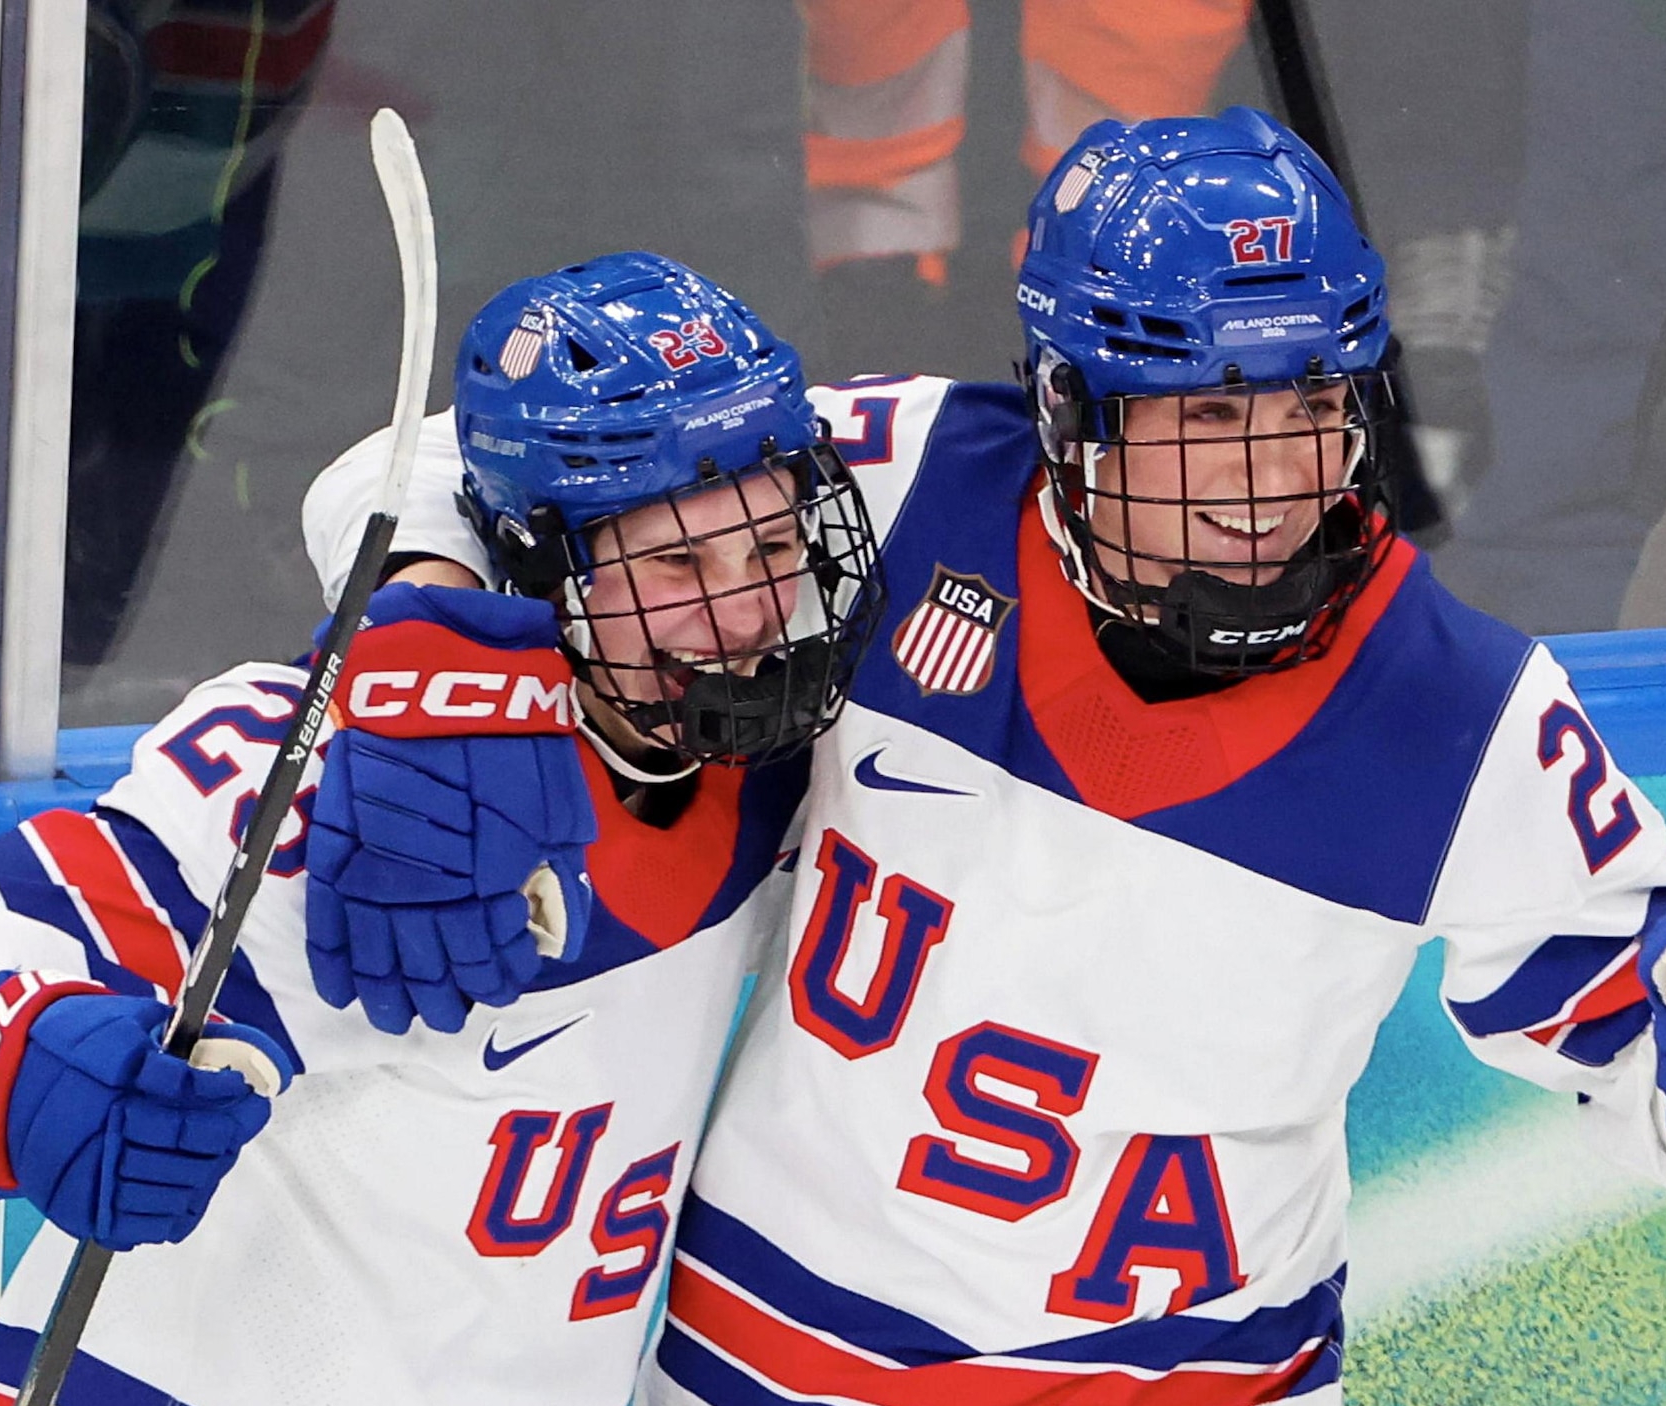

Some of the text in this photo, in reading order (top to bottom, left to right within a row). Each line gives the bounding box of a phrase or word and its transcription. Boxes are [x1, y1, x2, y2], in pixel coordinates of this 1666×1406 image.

[1229, 217, 1296, 266] 27
[520, 313, 546, 331] USA
[1016, 283, 1056, 316] CCM
[1220, 313, 1322, 331] MILANO CORTINA
[648, 320, 728, 371] 23
[938, 581, 995, 626] USA
[1209, 620, 1307, 645] CCM
[348, 670, 569, 727] CCM
[1538, 699, 1642, 875] 2
[788, 827, 1249, 1324] USA
[465, 1100, 682, 1322] US
